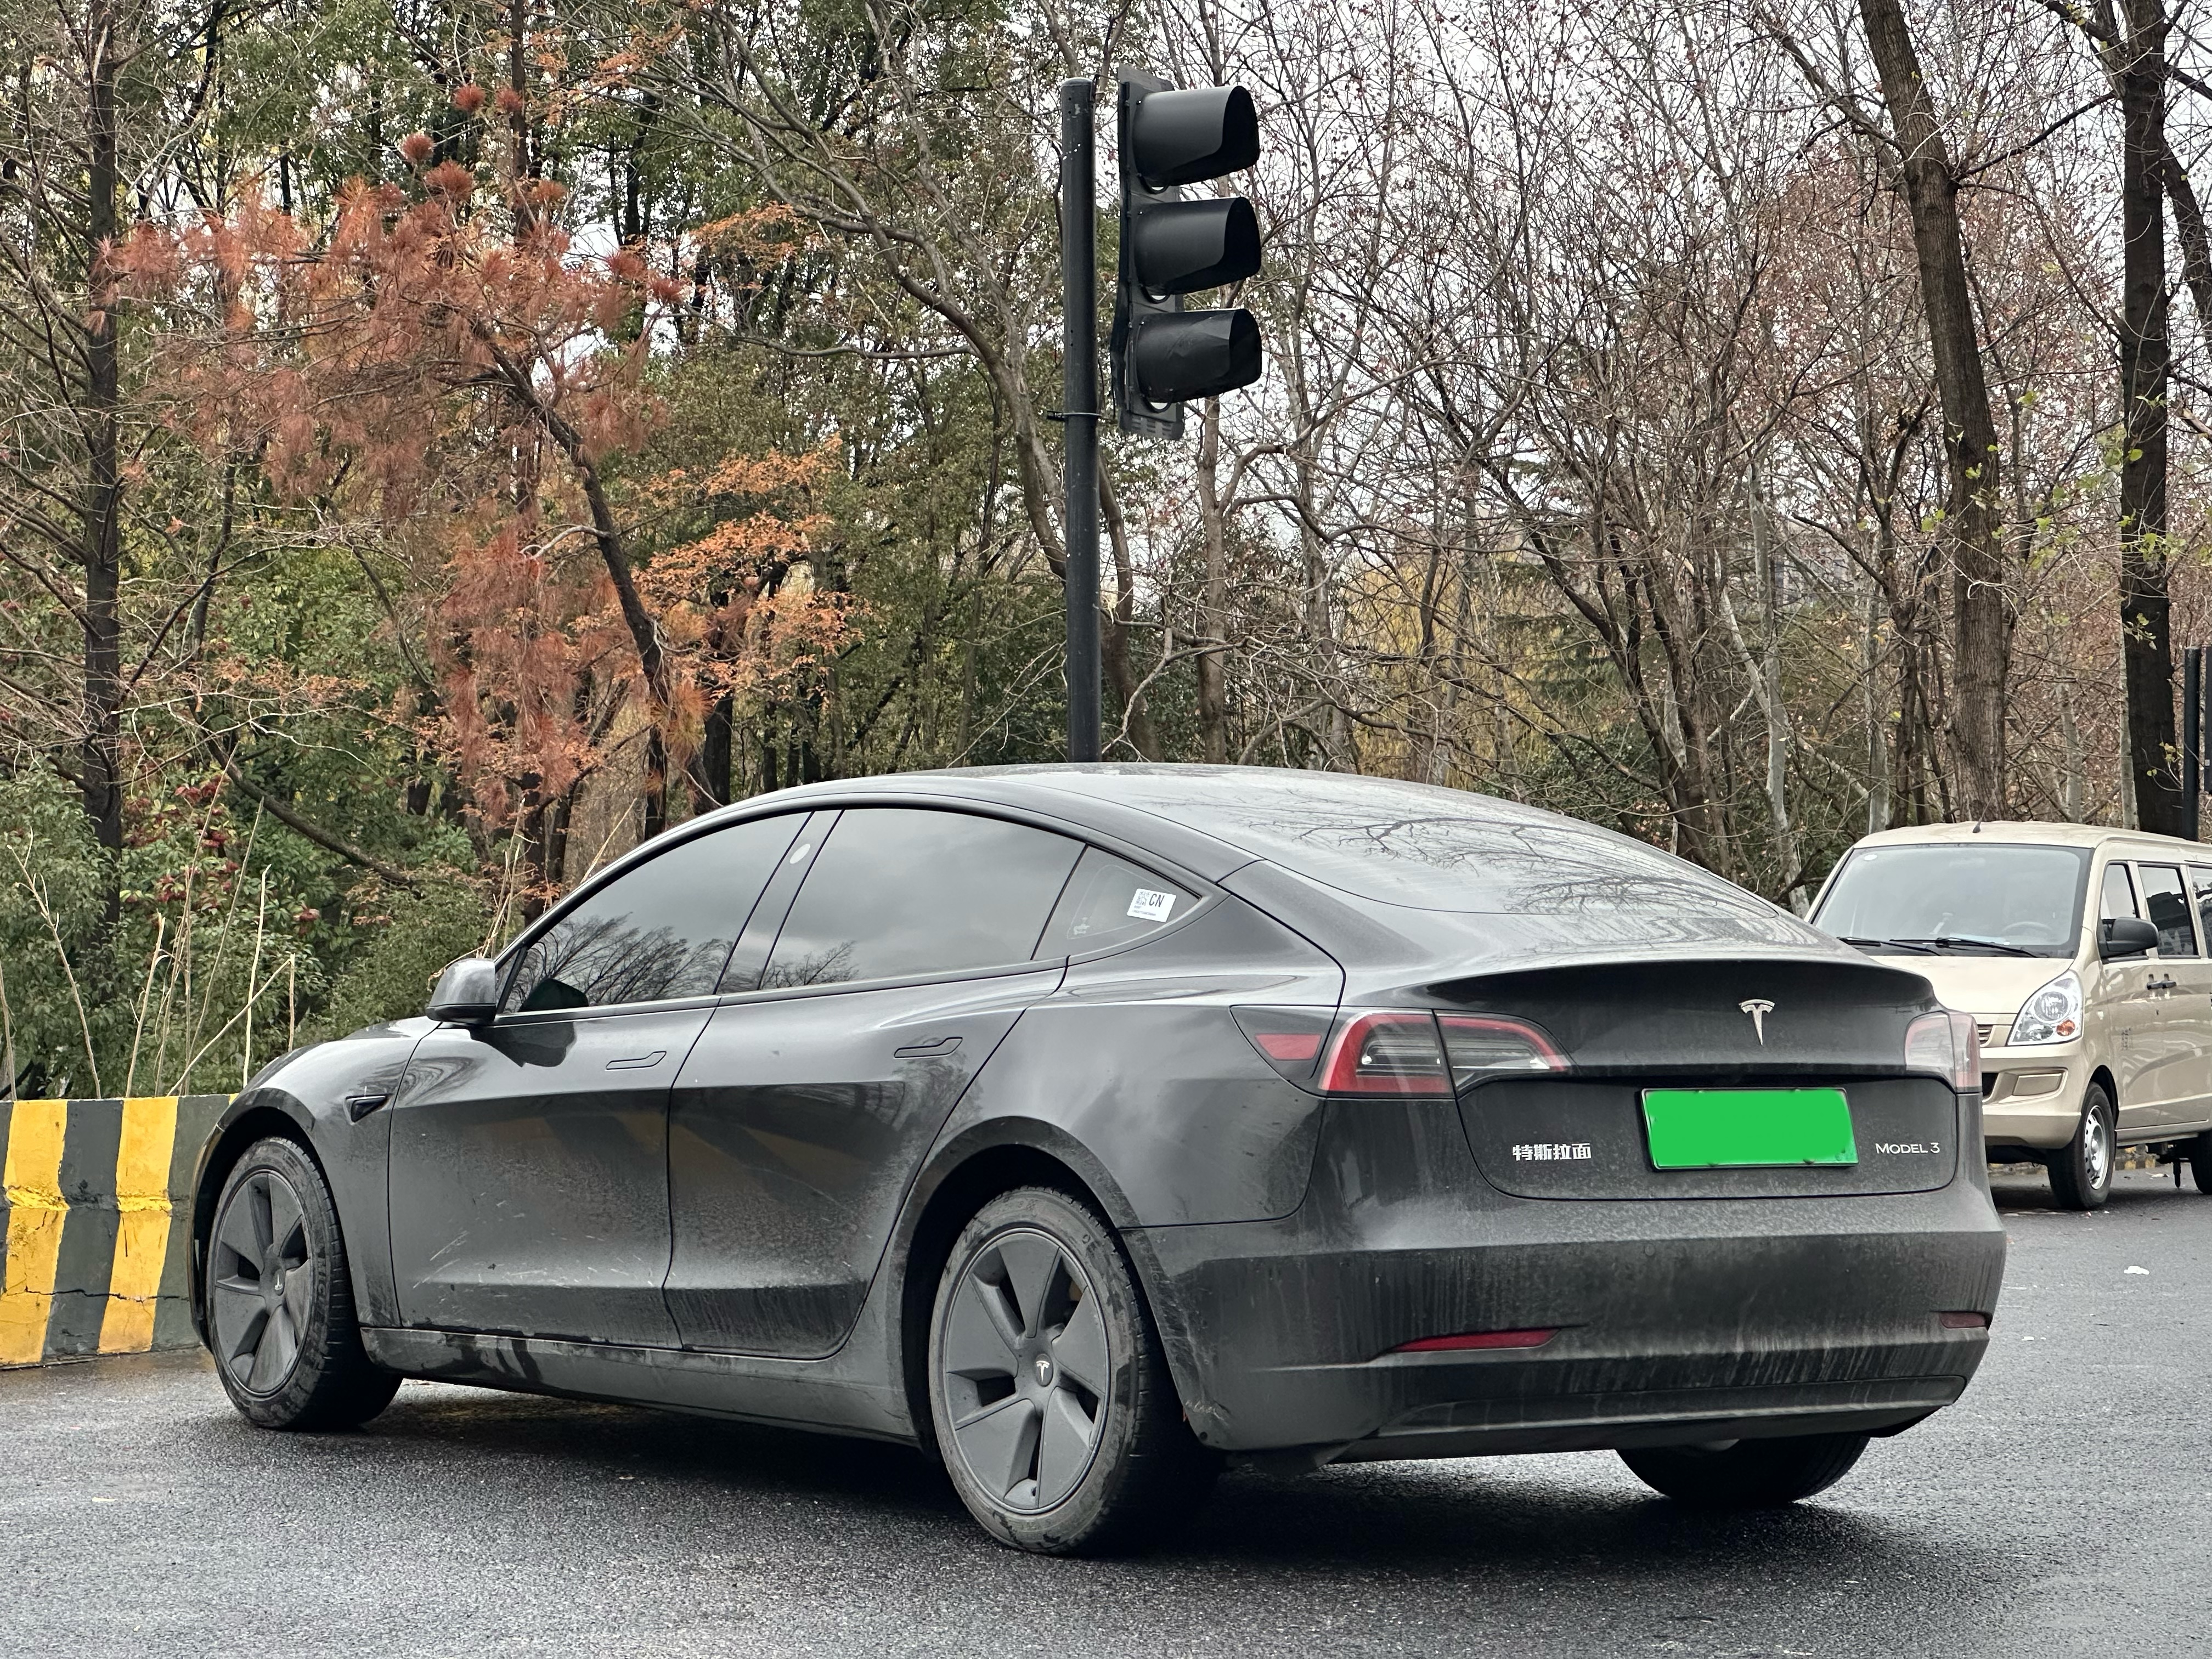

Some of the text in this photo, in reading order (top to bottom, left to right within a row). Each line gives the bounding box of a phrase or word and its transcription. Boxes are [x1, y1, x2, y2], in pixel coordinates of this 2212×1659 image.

[1149, 893, 1165, 907] CN
[1512, 1143, 1592, 1161] 特斯拉面
[1875, 1142, 1940, 1154] MODEL 3
